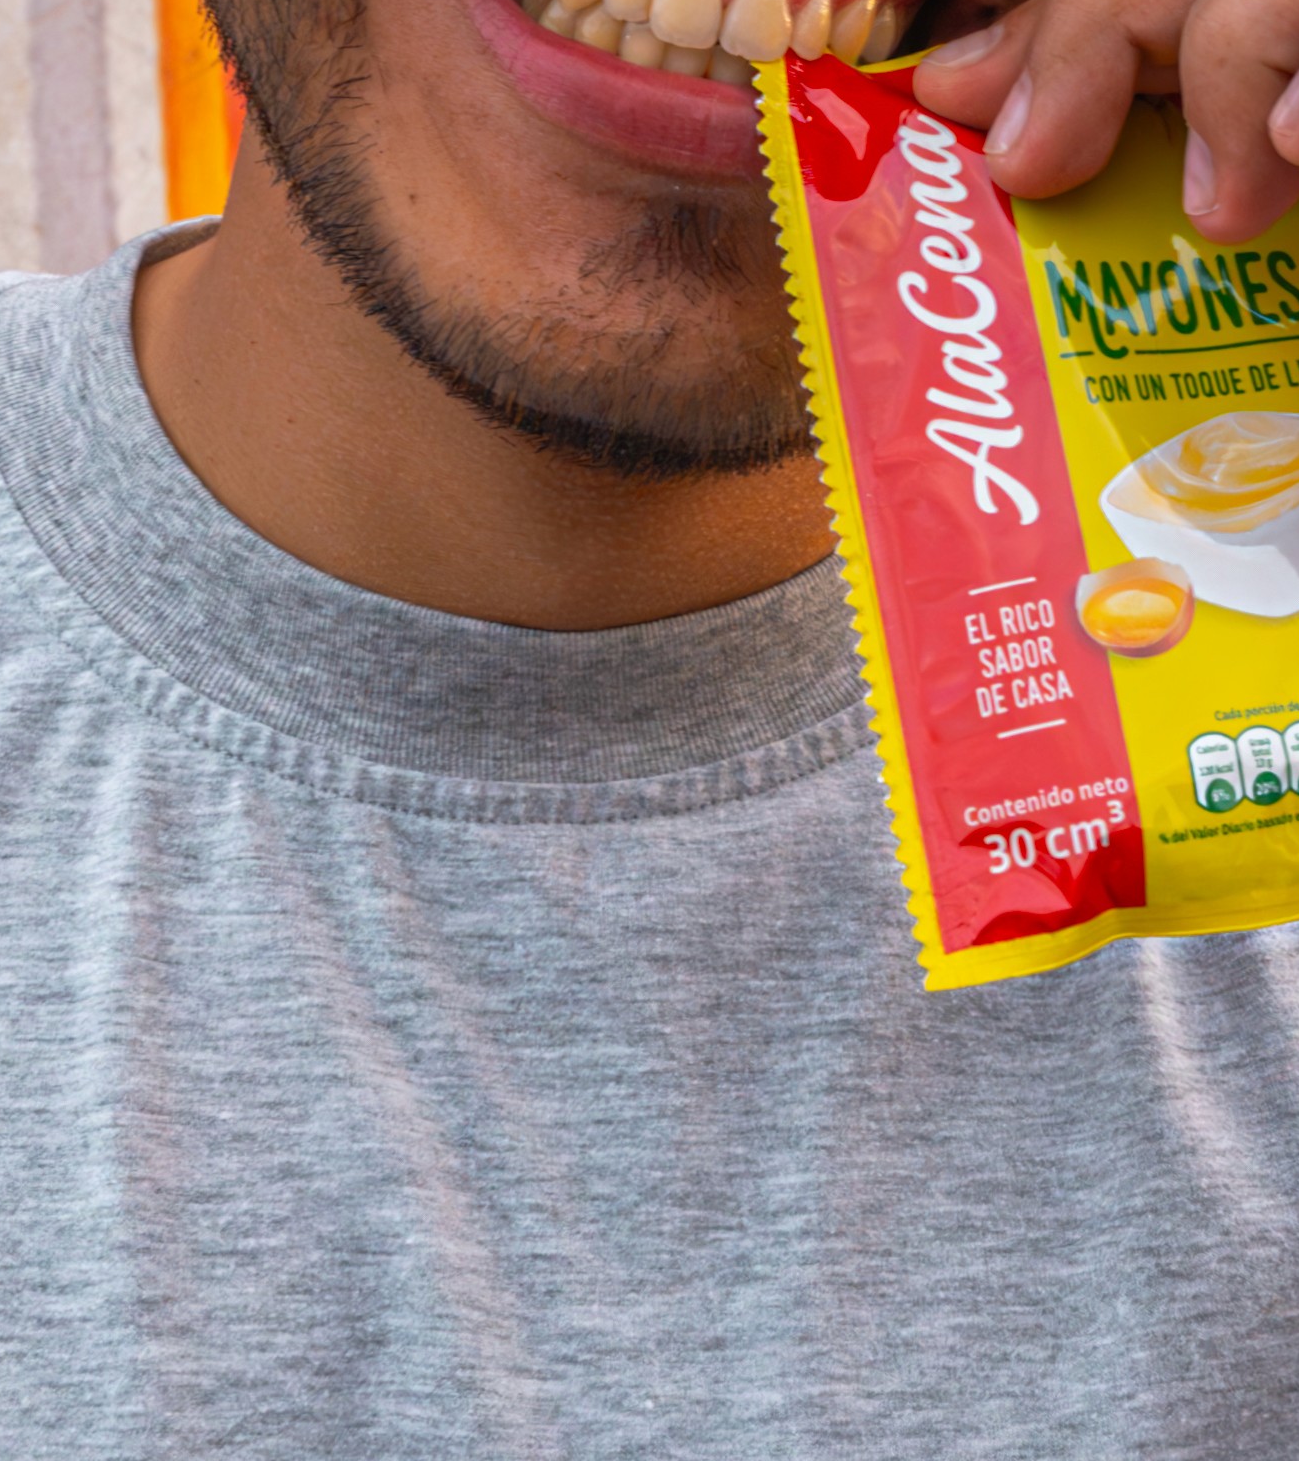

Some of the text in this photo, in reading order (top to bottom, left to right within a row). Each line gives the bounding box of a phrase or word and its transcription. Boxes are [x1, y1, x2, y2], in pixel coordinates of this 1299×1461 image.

[897, 113, 1040, 525] AlaCena
[1084, 373, 1132, 404] CON
[1136, 372, 1168, 400] UN
[1170, 368, 1246, 399] TOQUE
[1249, 362, 1280, 393] DE
[964, 599, 1055, 645] EL RICO
[978, 636, 1057, 678] SABOR
[975, 670, 1074, 718] DE CASA
[964, 777, 1129, 826] Contenido neto
[983, 828, 1037, 874] 30
